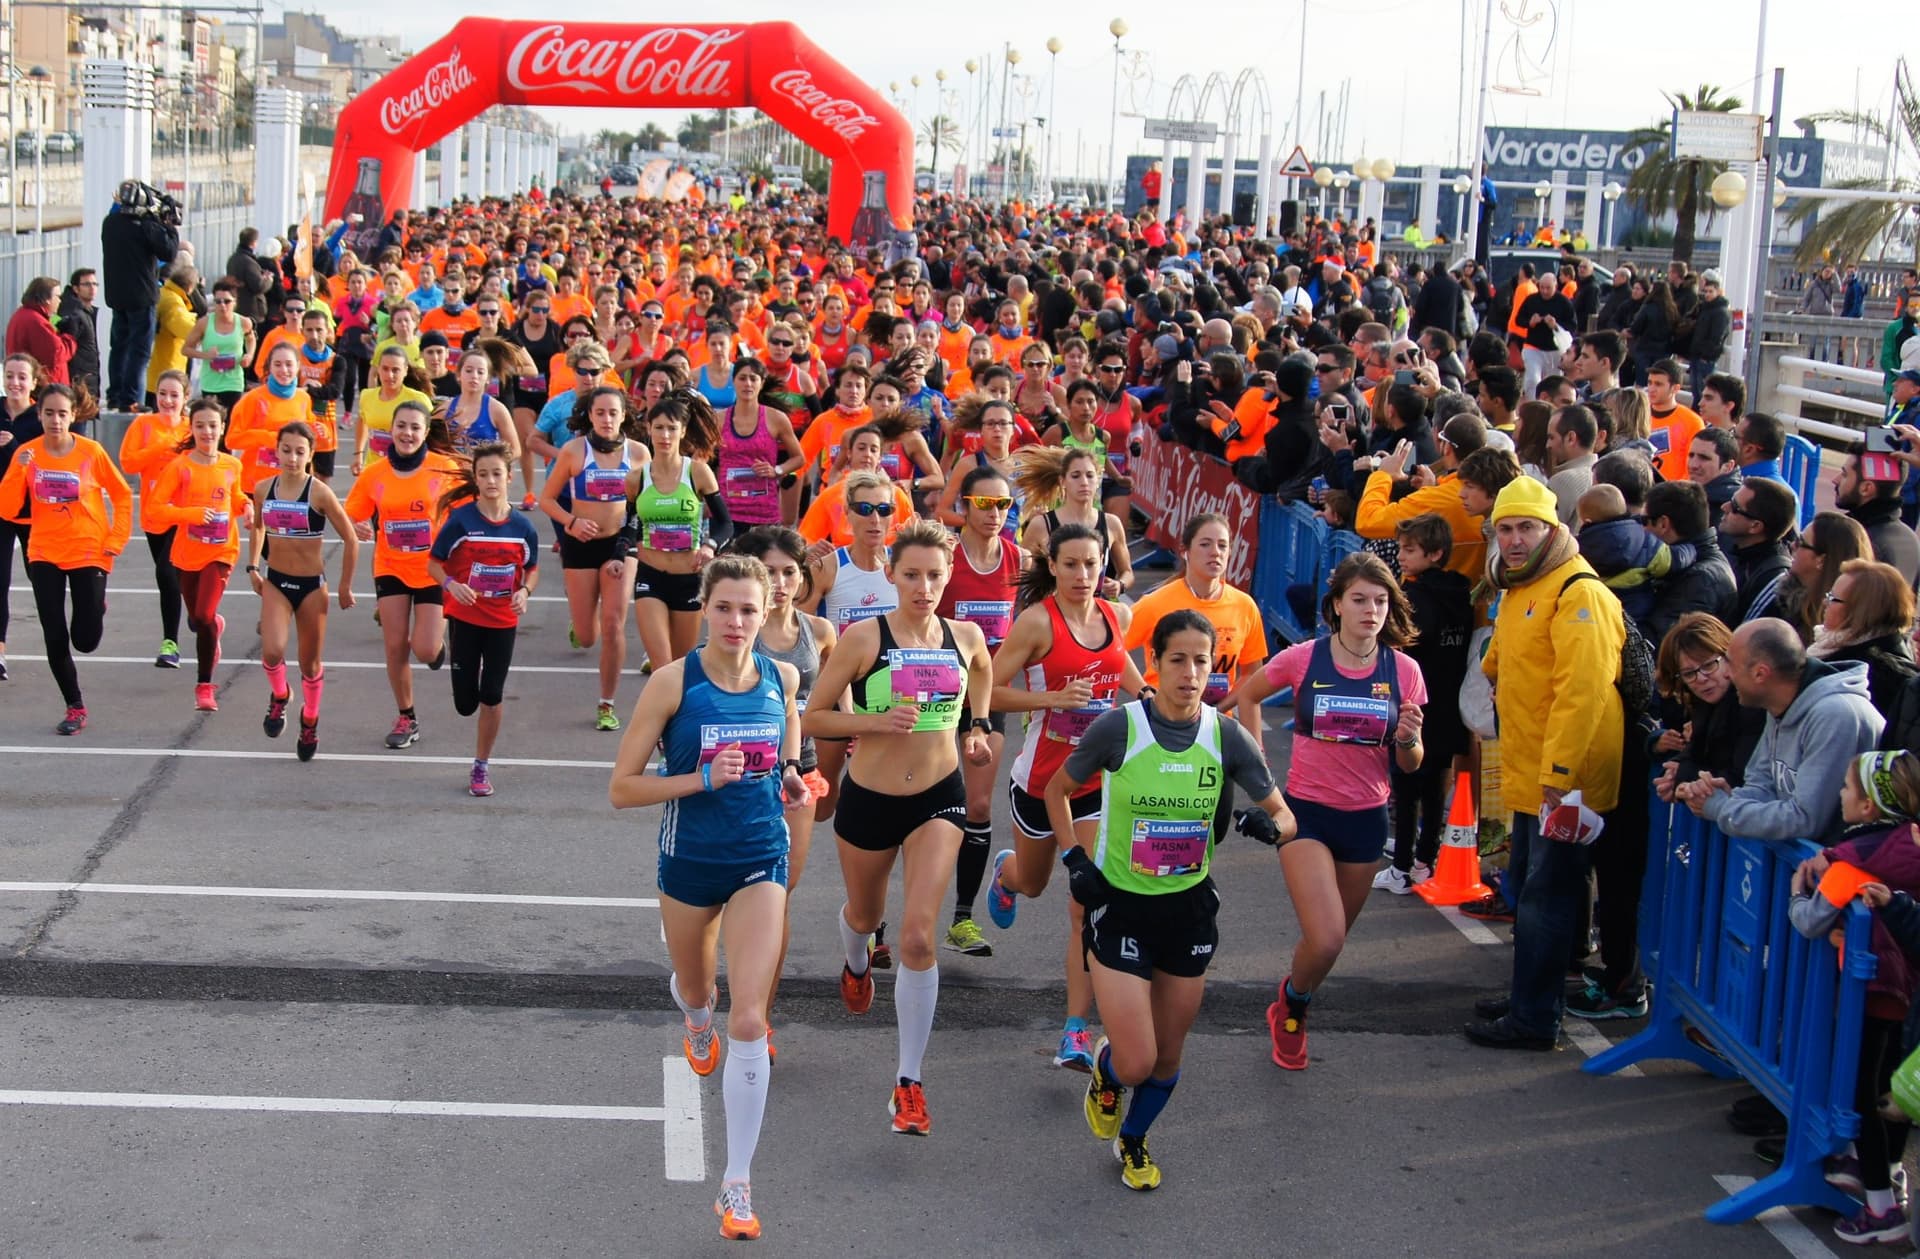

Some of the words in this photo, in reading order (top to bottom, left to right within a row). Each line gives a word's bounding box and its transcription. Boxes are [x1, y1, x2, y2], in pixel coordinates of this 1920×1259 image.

[506, 24, 745, 97] Coca-Cola
[380, 44, 474, 135] Coca-Cola
[770, 69, 881, 142] Coca-Cola
[1484, 130, 1645, 170] Varadero
[680, 500, 695, 511] LS
[840, 608, 851, 619] LS
[957, 603, 969, 613] LS
[892, 651, 903, 663] LS
[913, 668, 940, 678] INNA
[1317, 697, 1328, 709] LS
[1331, 701, 1386, 711] LASANSI.COM
[705, 727, 719, 740] LS
[721, 729, 778, 738] LASANSI.COM
[1198, 767, 1216, 788] LS
[1131, 795, 1216, 809] LASANSI.COM
[1151, 842, 1191, 851] HASNA
[1121, 936, 1139, 958] LS
